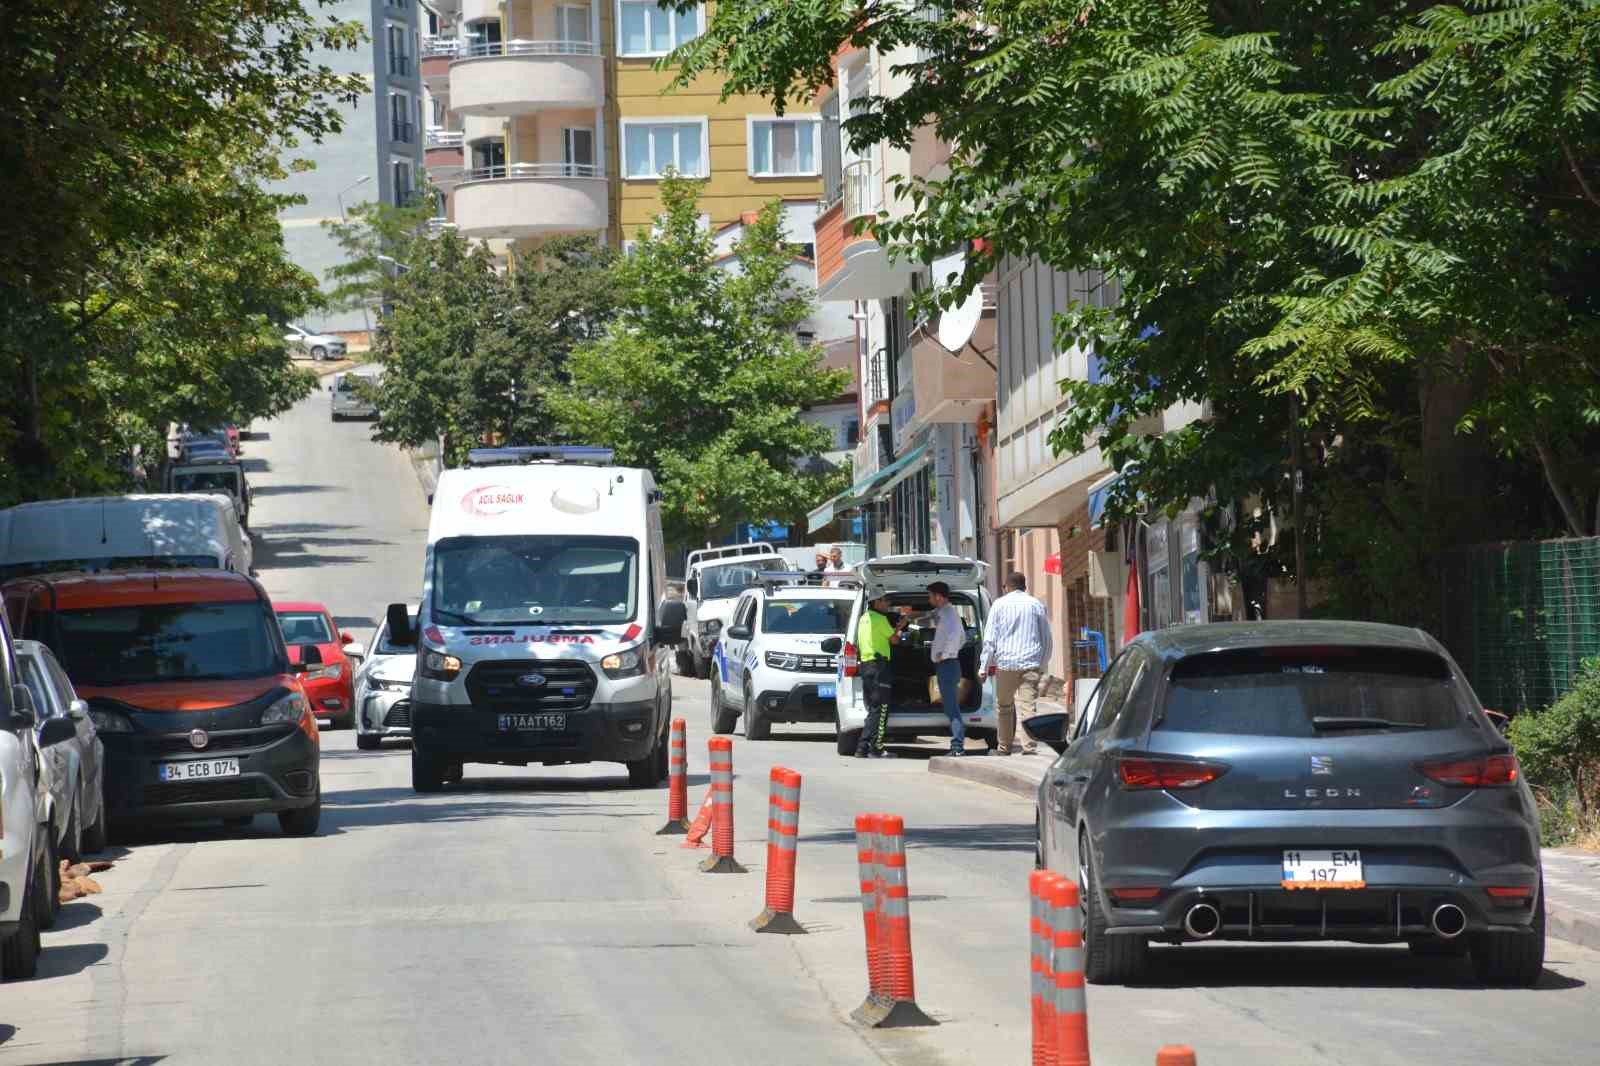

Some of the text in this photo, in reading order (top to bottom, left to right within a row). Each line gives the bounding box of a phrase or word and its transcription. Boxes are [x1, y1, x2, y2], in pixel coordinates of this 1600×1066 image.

[167, 761, 236, 779] 34 ECB 074
[1284, 788, 1361, 798] LEON
[1287, 851, 1358, 867] 11 EM
[1311, 868, 1337, 882] 197
